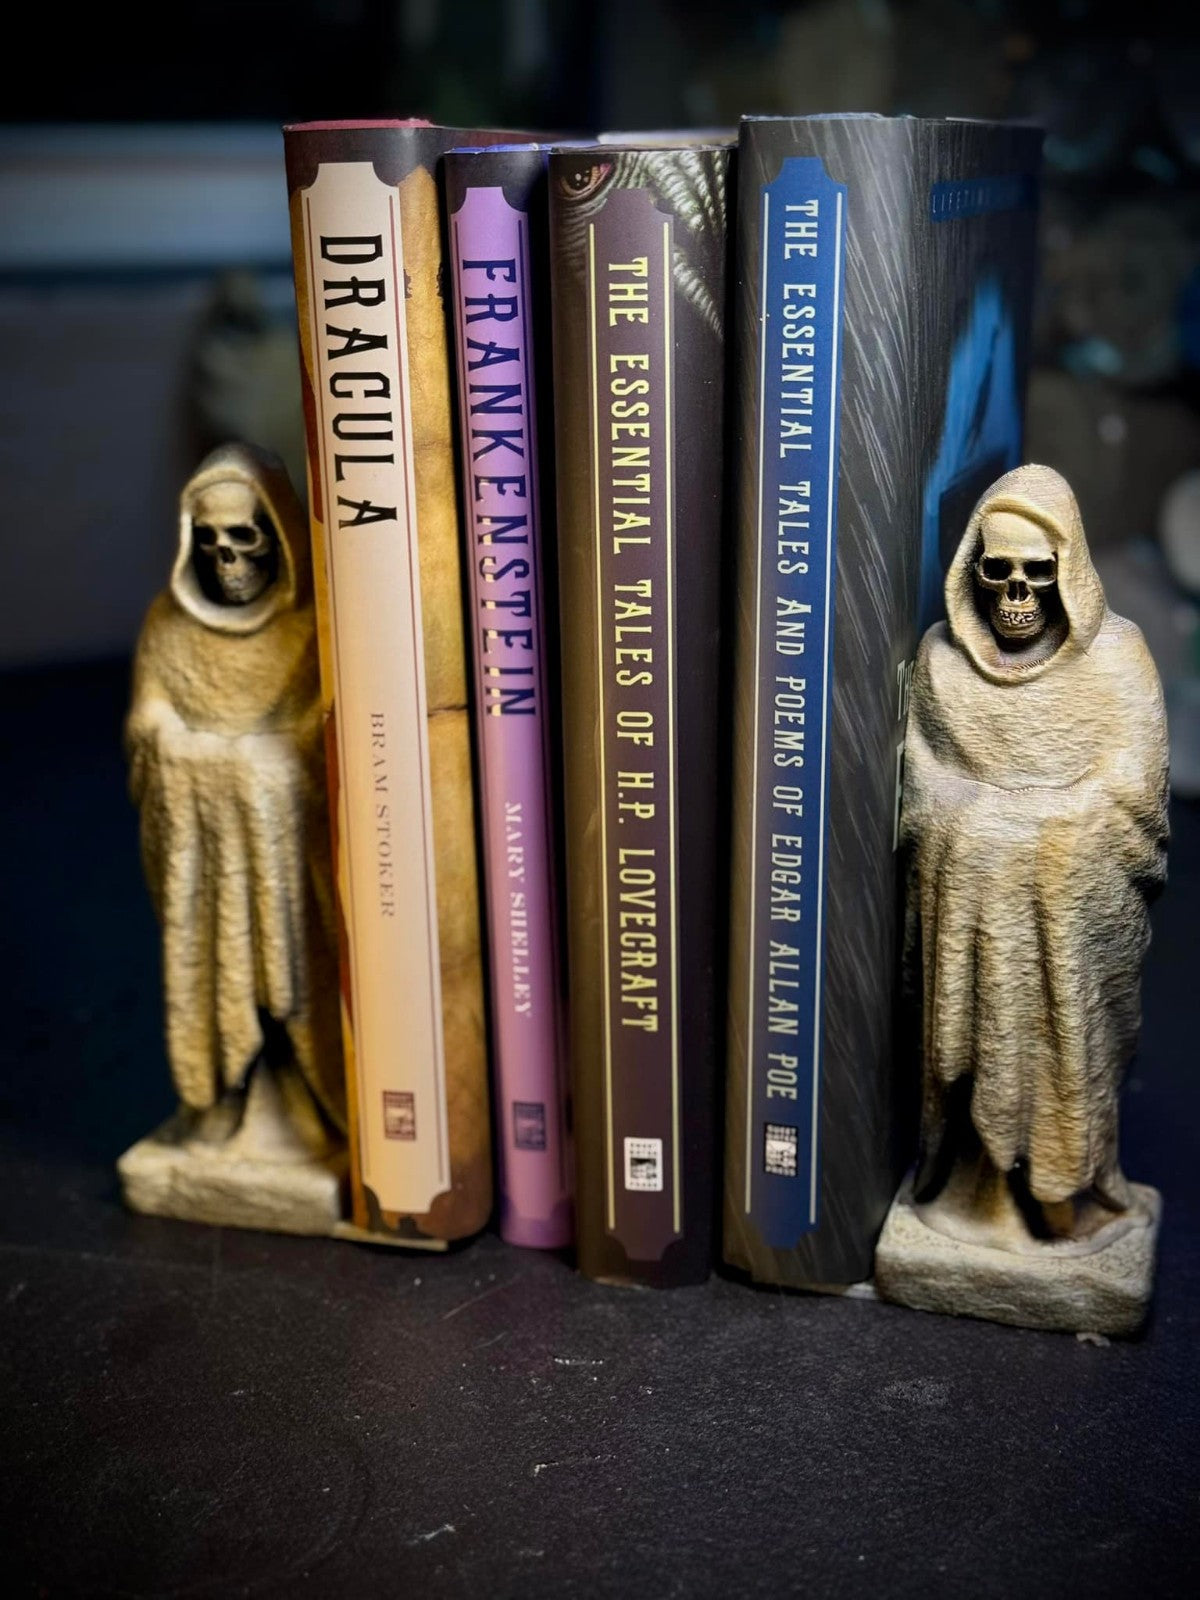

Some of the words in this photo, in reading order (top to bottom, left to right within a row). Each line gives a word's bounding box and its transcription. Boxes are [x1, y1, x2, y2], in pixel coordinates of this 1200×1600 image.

[784, 199, 819, 260] THE
[608, 257, 649, 327] THE
[319, 234, 398, 530] DRACULA
[779, 283, 816, 459] ESSENTIAL
[462, 258, 536, 717] FRANKENSTEIN
[610, 353, 652, 555] ESSENTIAL
[776, 480, 811, 575] TALES
[614, 579, 653, 686] TALES
[775, 596, 811, 656] AND
[616, 711, 654, 747] OF
[773, 676, 806, 768] POEMS
[896, 659, 915, 722] TH
[370, 712, 388, 796] BRAM
[617, 771, 655, 824] H.P.
[505, 800, 525, 883] MARY
[772, 785, 803, 817] OF
[376, 804, 395, 918] STOKER
[770, 833, 802, 922] EDGAR
[510, 892, 532, 1017] SHELLEY
[618, 848, 658, 1033] LOVECRAFT
[768, 940, 800, 1036] ALLAN
[766, 1053, 798, 1100] POE
